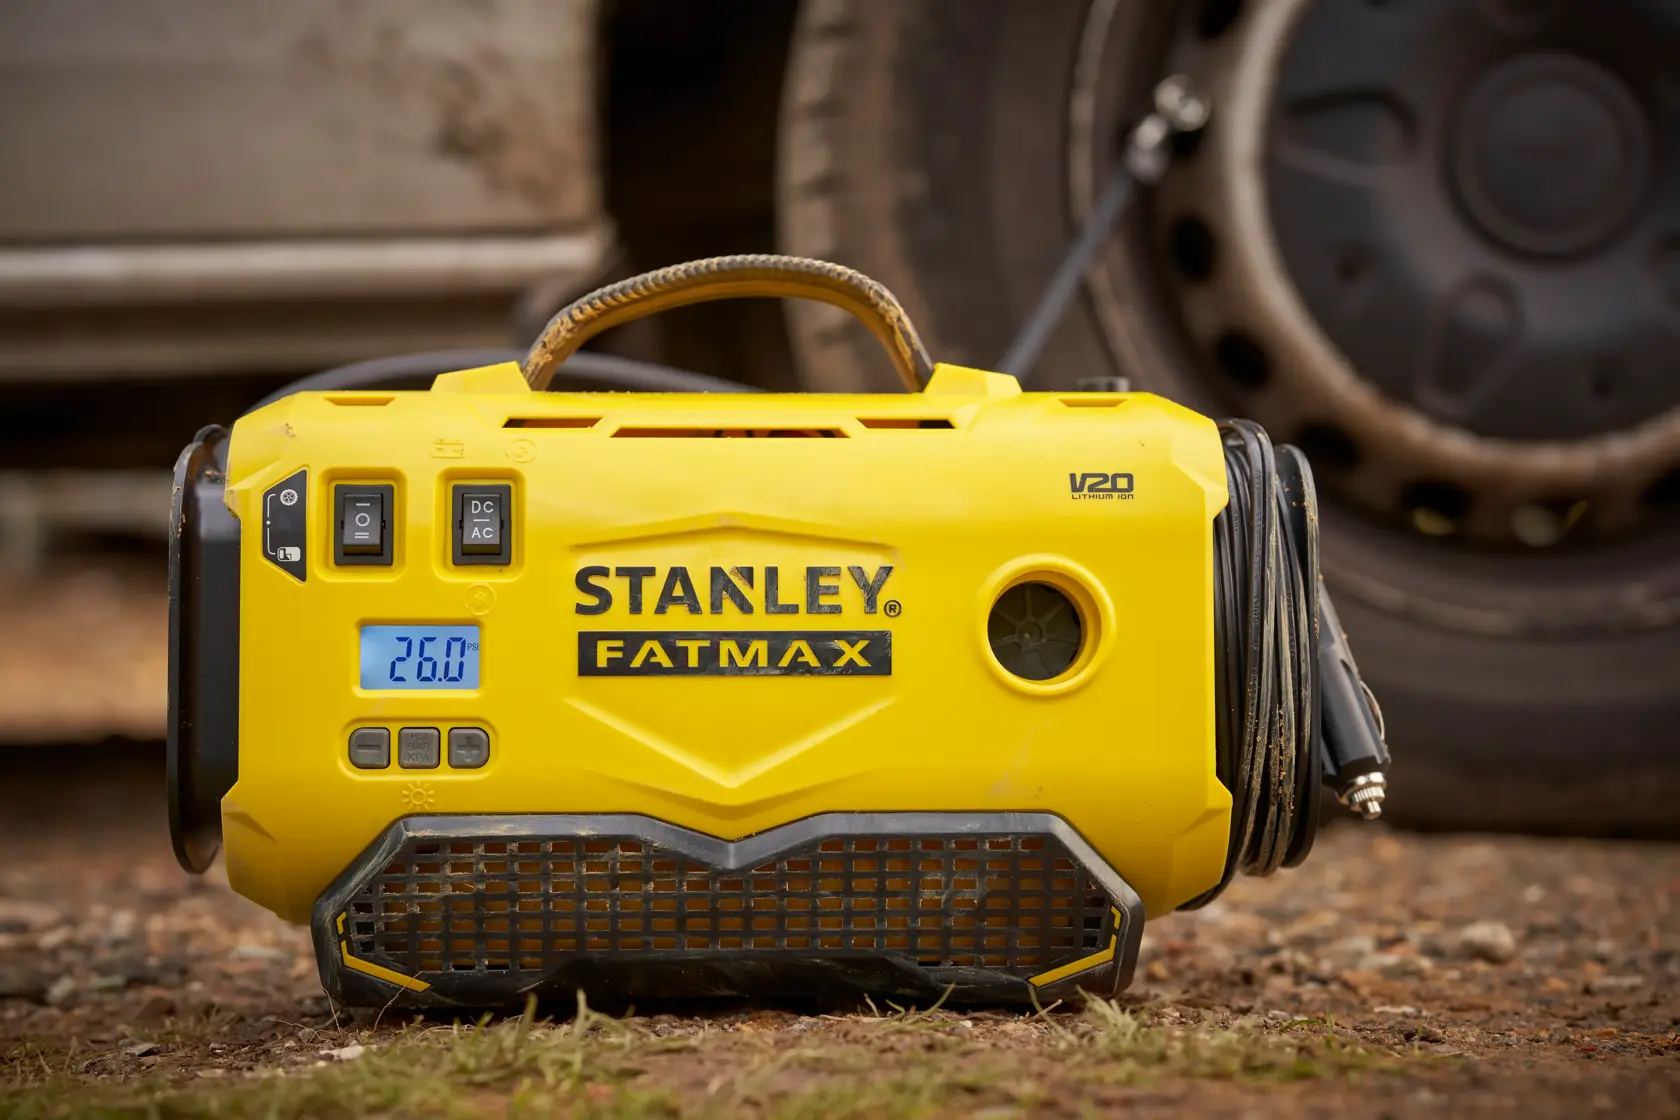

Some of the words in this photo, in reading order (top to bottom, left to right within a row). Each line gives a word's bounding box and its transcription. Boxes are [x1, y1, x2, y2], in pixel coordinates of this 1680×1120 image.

[1069, 473, 1134, 493] V20
[471, 501, 494, 514] DC
[471, 527, 494, 539] AC
[575, 566, 893, 615] STANLEY
[389, 636, 466, 682] 26.0
[467, 643, 479, 651] PSI
[596, 639, 872, 668] FATMAX
[410, 732, 428, 741] PSI
[407, 743, 430, 751] BAR
[408, 753, 430, 762] KPA
